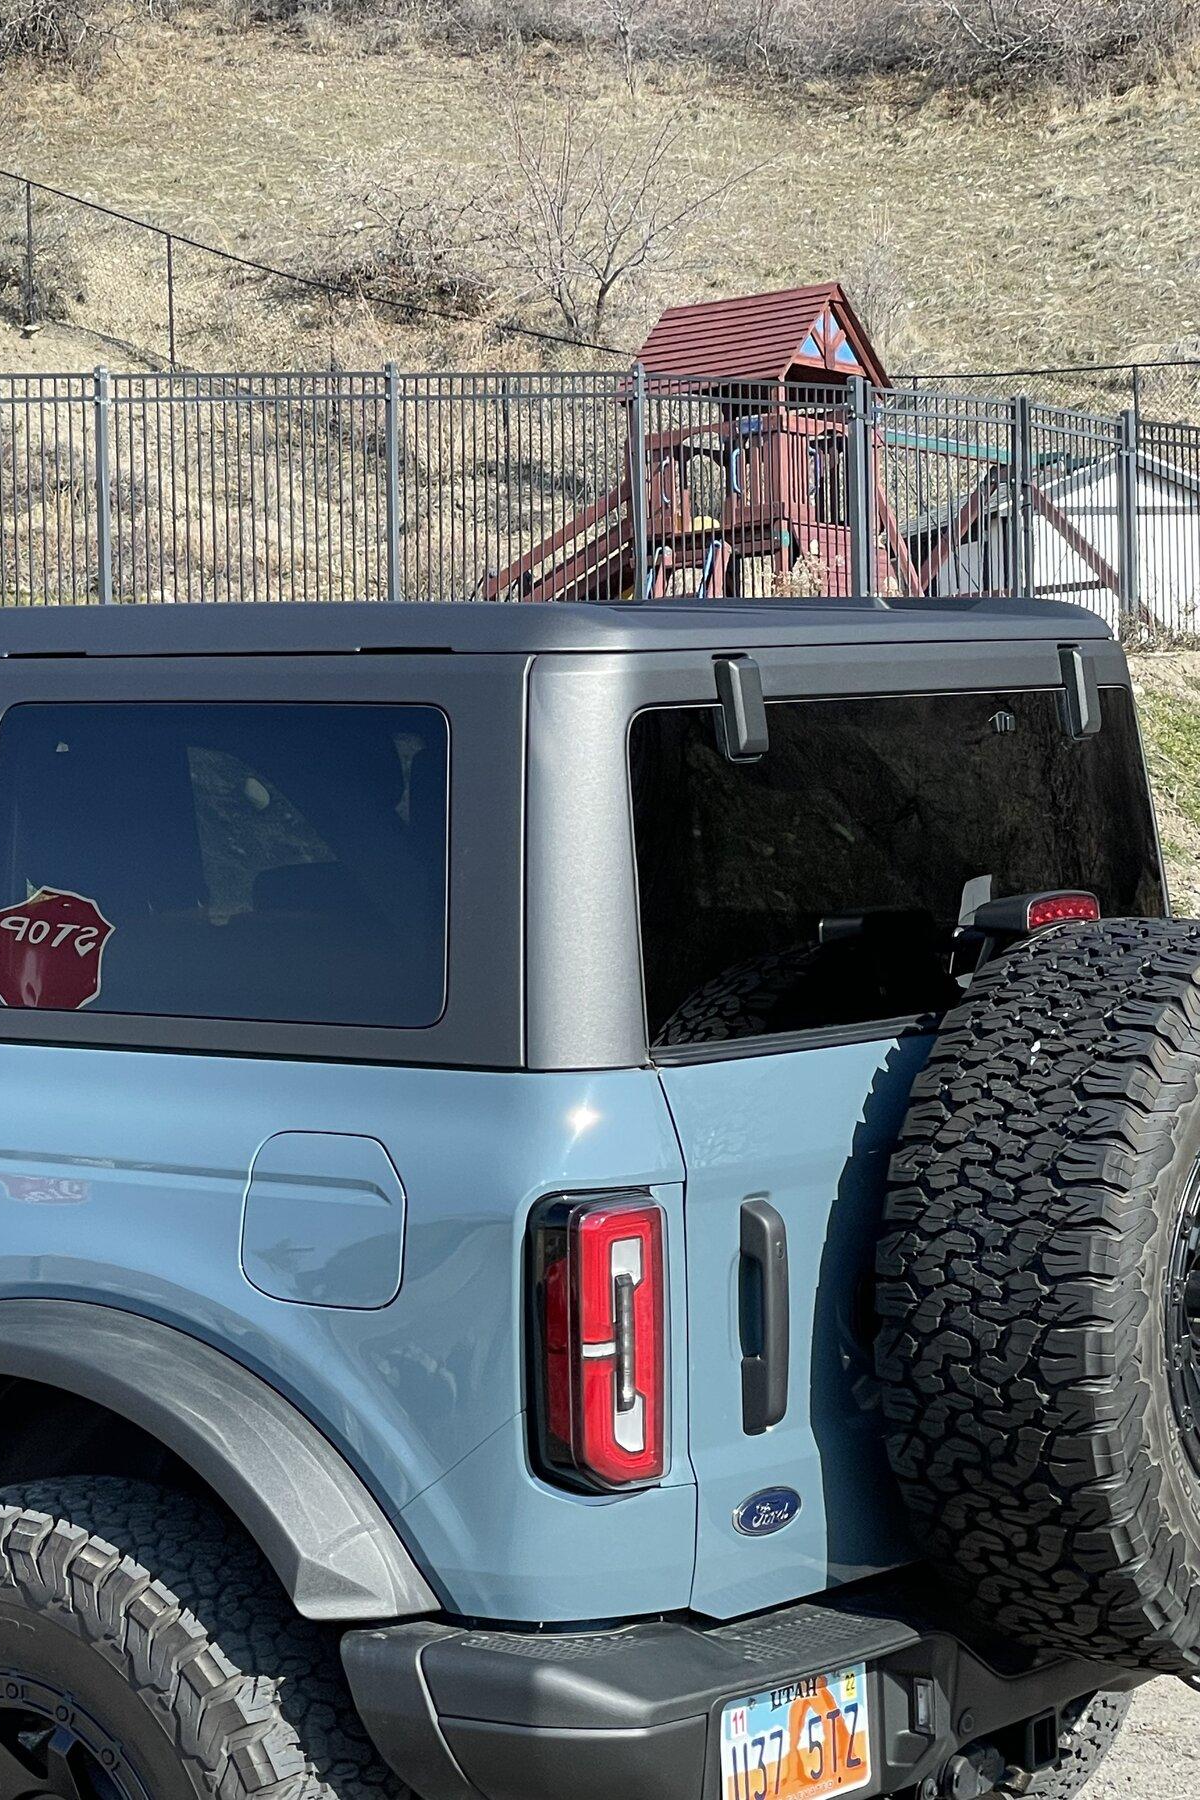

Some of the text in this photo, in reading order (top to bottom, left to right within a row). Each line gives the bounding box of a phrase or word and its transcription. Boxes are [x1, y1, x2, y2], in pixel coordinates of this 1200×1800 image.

[752, 1502, 789, 1528] Ford
[770, 1677, 817, 1712] UTAH
[808, 1703, 861, 1780] 5TZ
